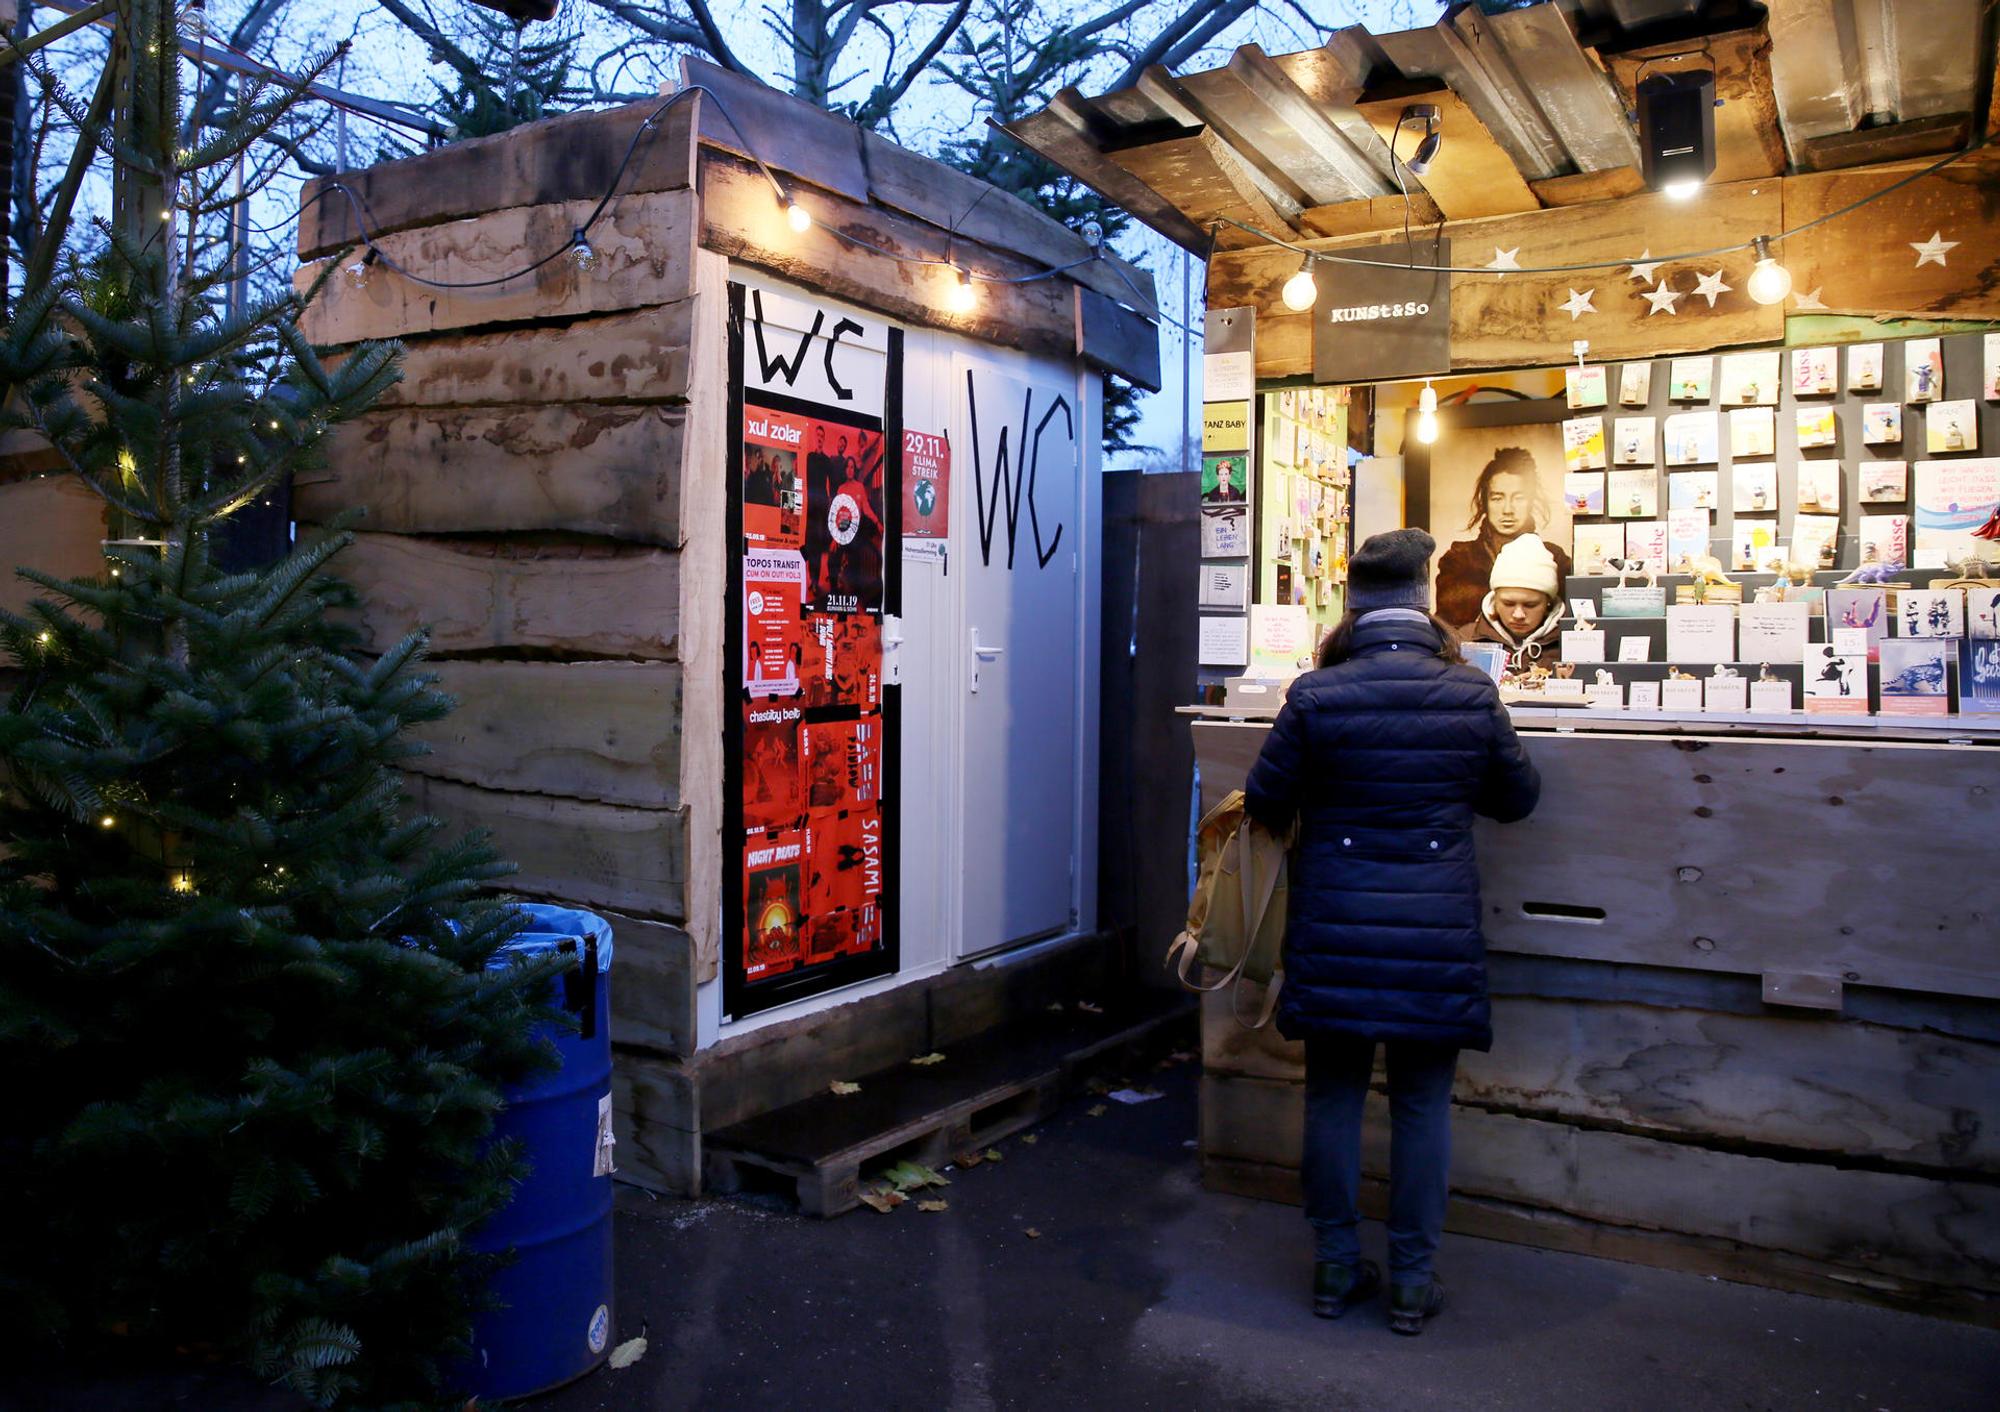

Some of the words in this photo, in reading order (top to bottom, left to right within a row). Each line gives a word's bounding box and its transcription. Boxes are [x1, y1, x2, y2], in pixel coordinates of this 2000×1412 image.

[752, 288, 864, 401] WC
[748, 419, 768, 438] xul
[770, 423, 802, 444] zolar
[1204, 421, 1224, 429] TANZ
[1225, 420, 1246, 429] BABY
[905, 433, 944, 459] 29.11.
[913, 455, 938, 468] KLIMA
[967, 368, 1074, 570] WC
[911, 466, 939, 480] STREIK
[746, 558, 772, 569] TOPOS
[773, 559, 801, 570] TRANSIT
[746, 569, 759, 577] CUM
[761, 570, 770, 578] ON
[827, 594, 858, 607] 21.11.19
[749, 709, 782, 724] chastity
[782, 707, 801, 720] belt
[747, 848, 775, 868] NIGHT
[862, 818, 880, 894] SASAMI
